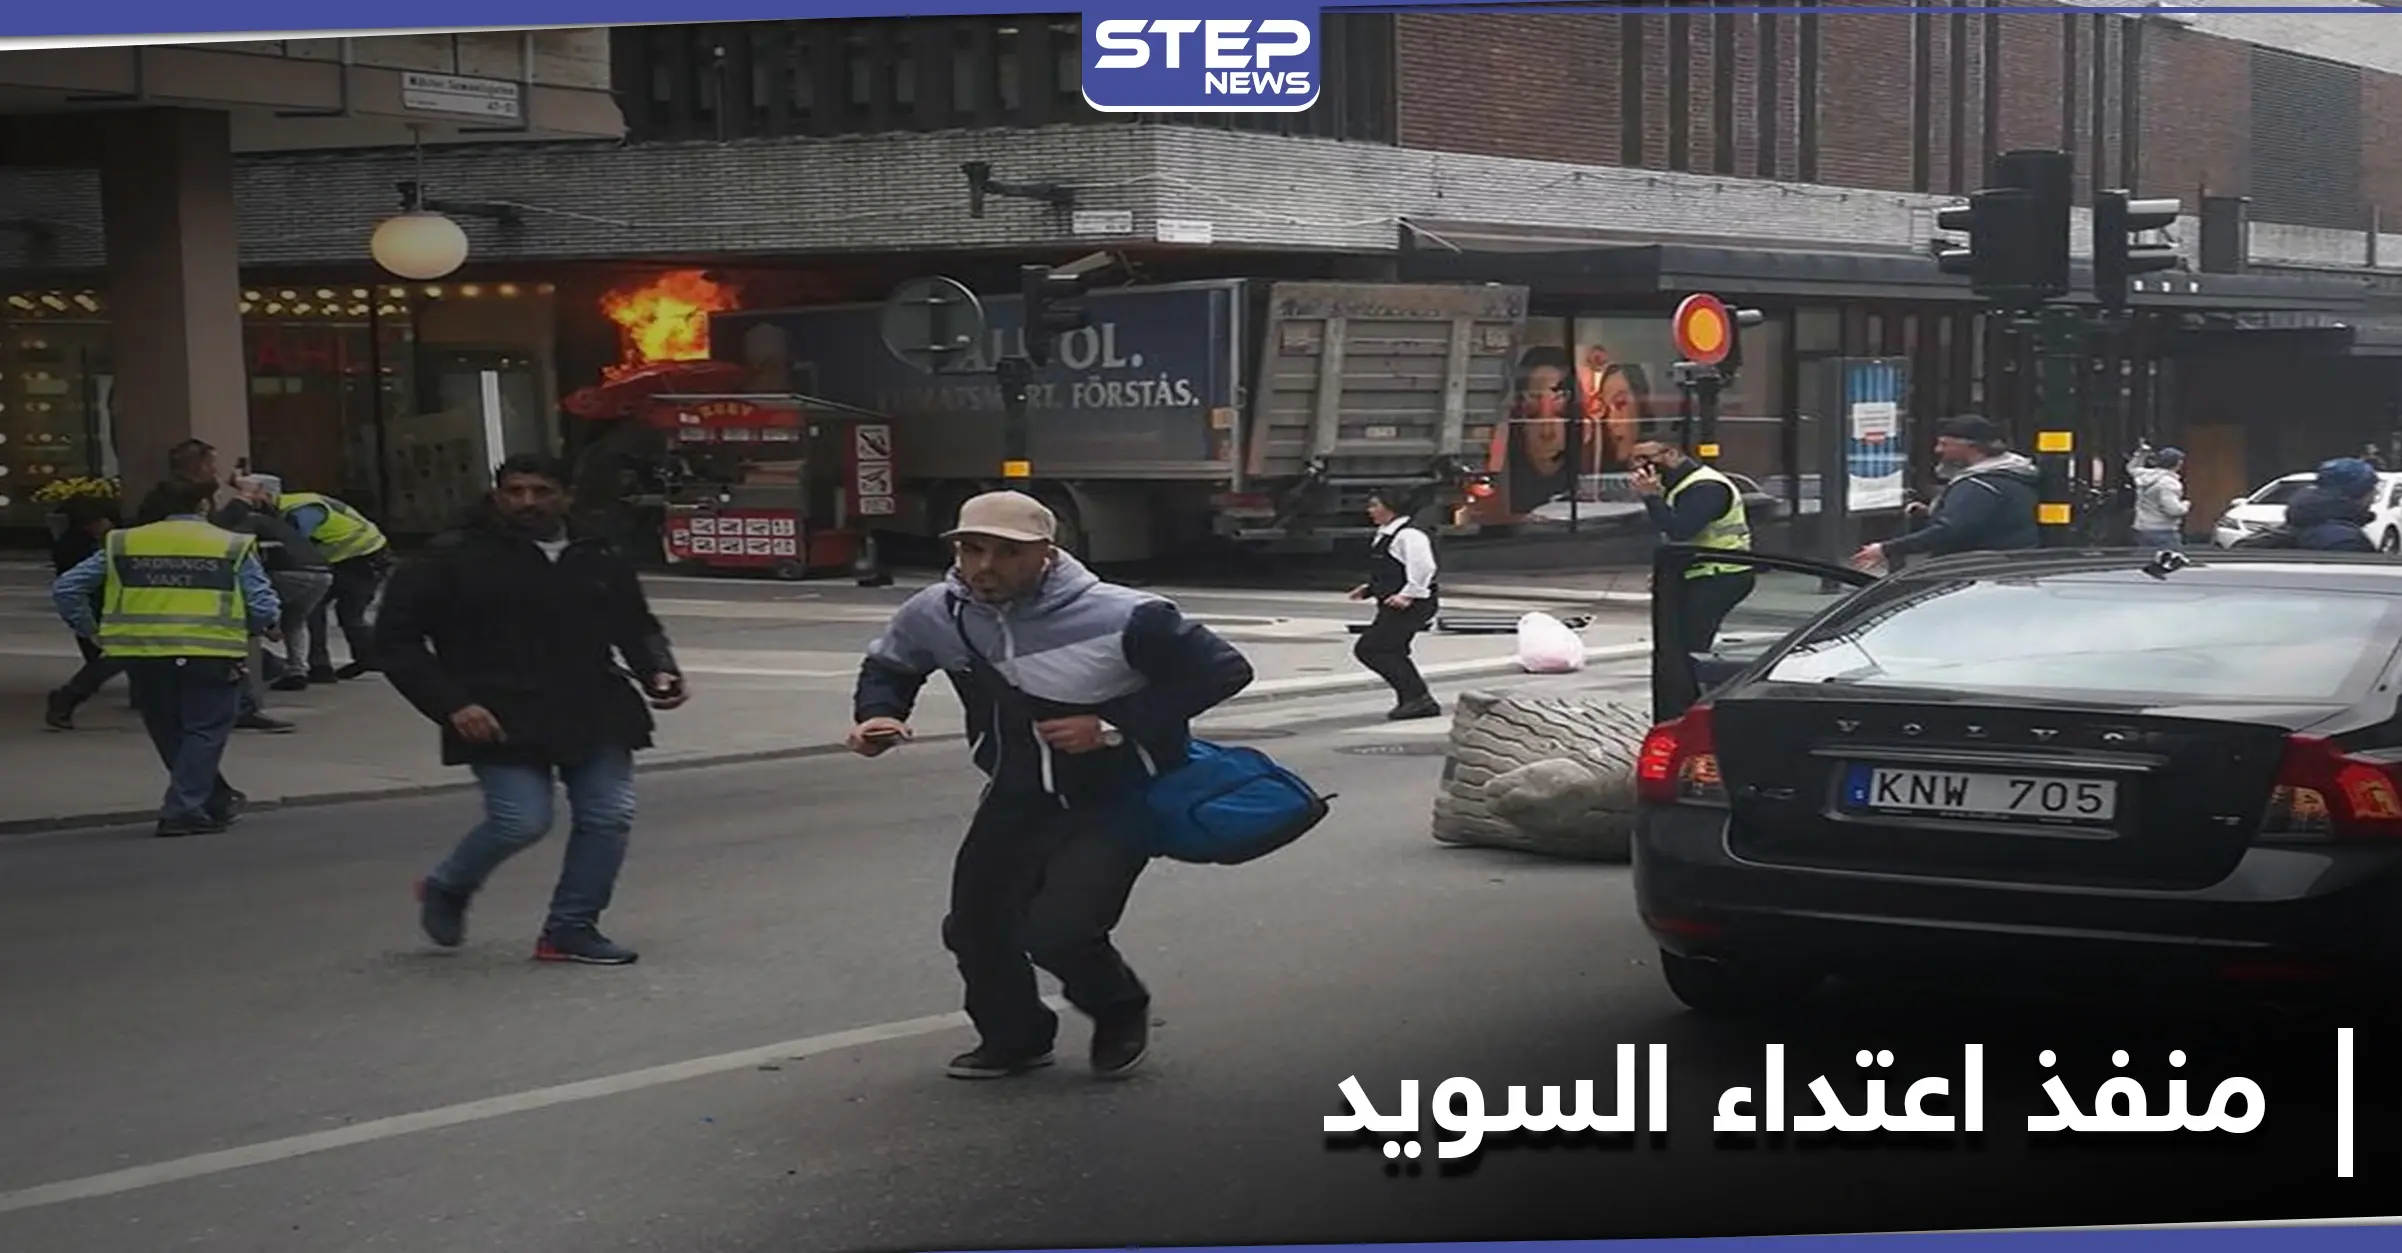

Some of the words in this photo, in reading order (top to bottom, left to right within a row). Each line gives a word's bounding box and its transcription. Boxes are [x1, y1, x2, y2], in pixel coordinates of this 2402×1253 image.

[1072, 371, 1200, 411] FÖRSTÅS.
[1877, 772, 1969, 808] KNW
[2009, 778, 2104, 815] 705
